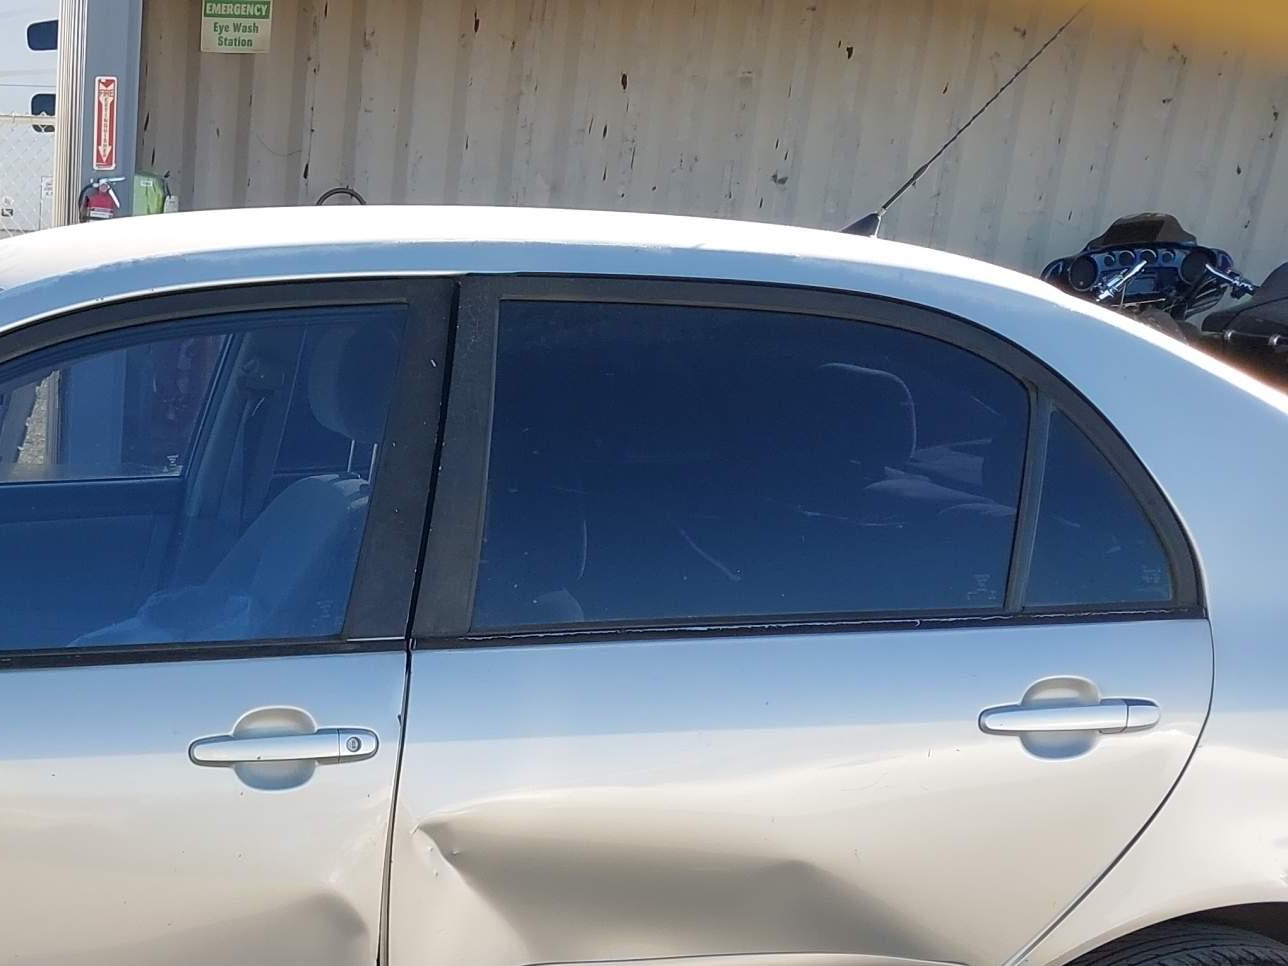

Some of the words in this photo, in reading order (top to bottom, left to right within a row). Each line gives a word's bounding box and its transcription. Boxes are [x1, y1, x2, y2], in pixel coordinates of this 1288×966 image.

[206, 3, 268, 16] EMERGENCY
[213, 22, 230, 35] Eye
[233, 22, 259, 33] Wash
[217, 36, 253, 47] Station
